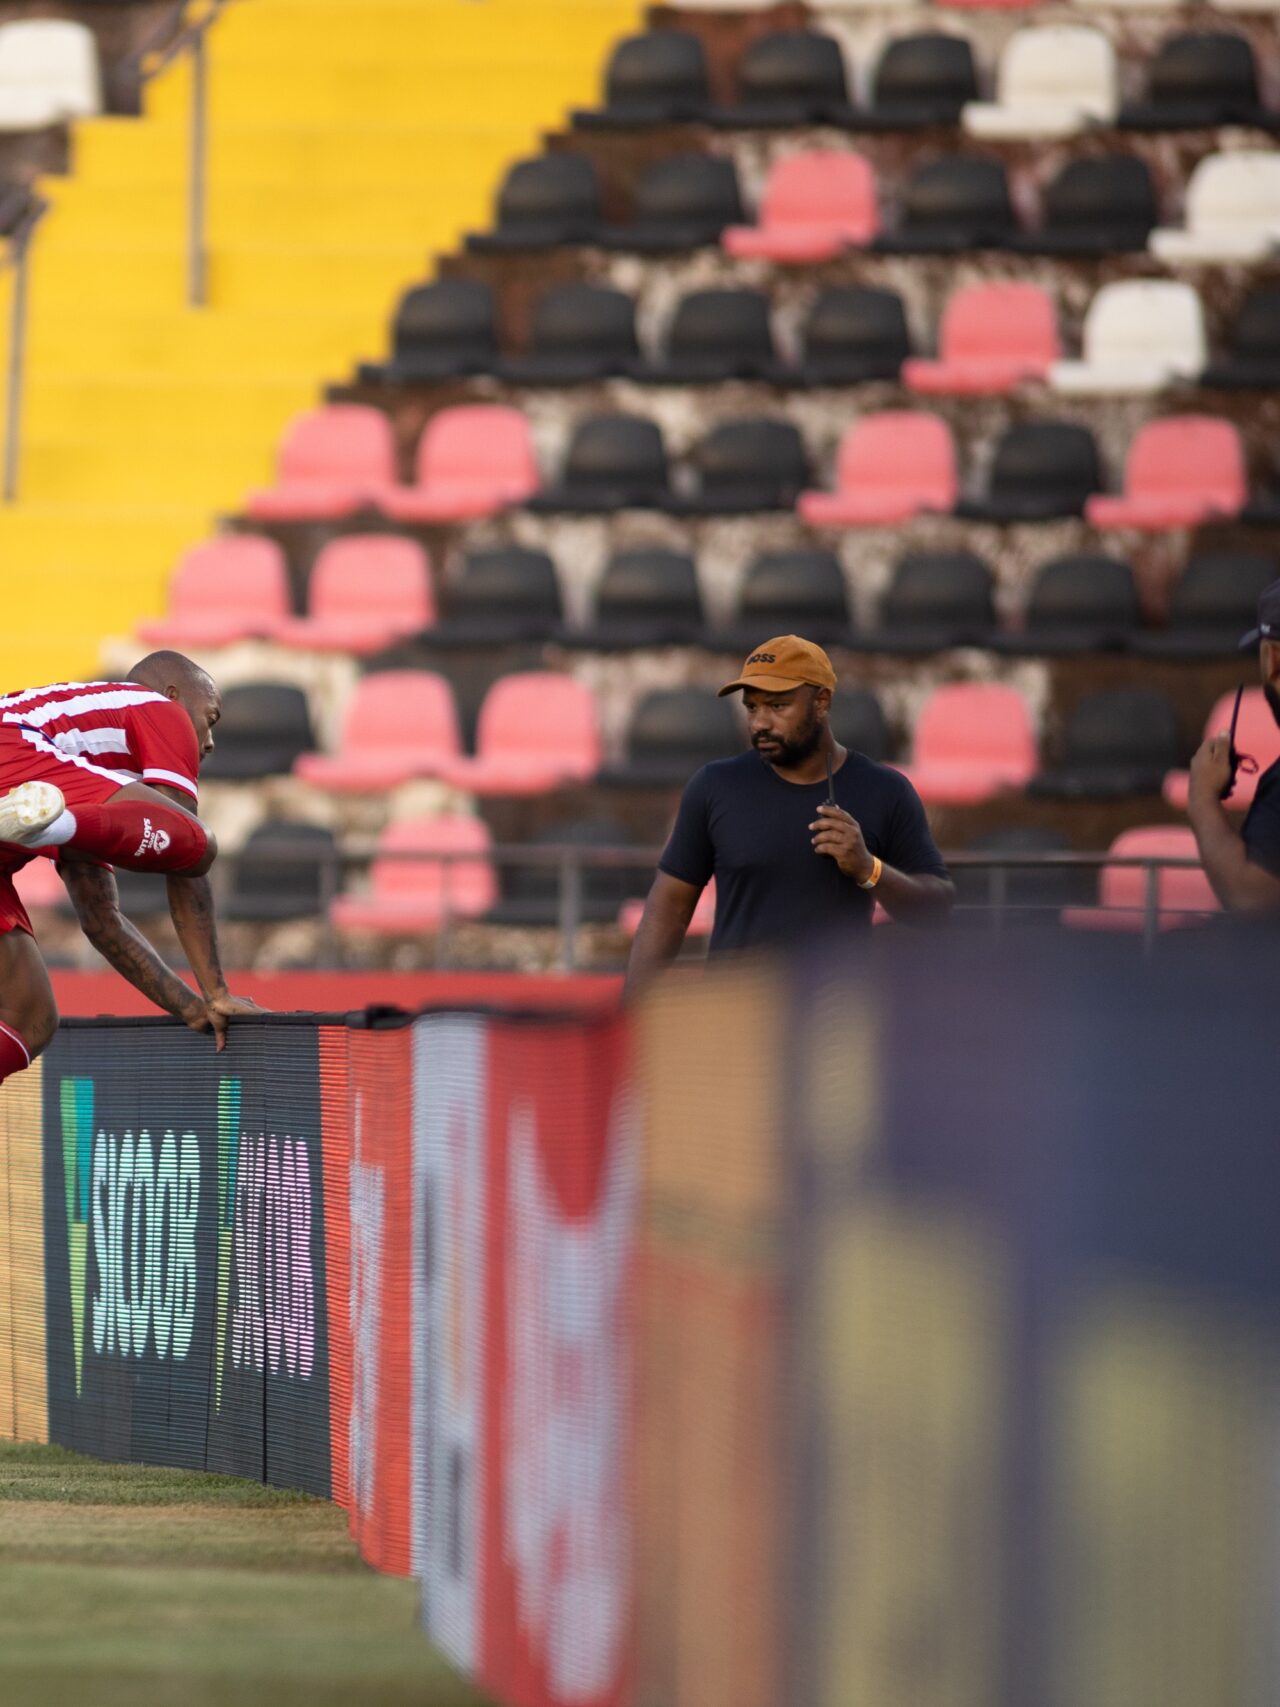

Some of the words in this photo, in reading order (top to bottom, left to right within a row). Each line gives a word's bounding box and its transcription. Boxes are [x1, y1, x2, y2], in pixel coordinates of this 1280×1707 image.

[144, 818, 152, 838] SÃO
[92, 1128, 201, 1361] SICOOB
[232, 1131, 315, 1382] SICOOB
